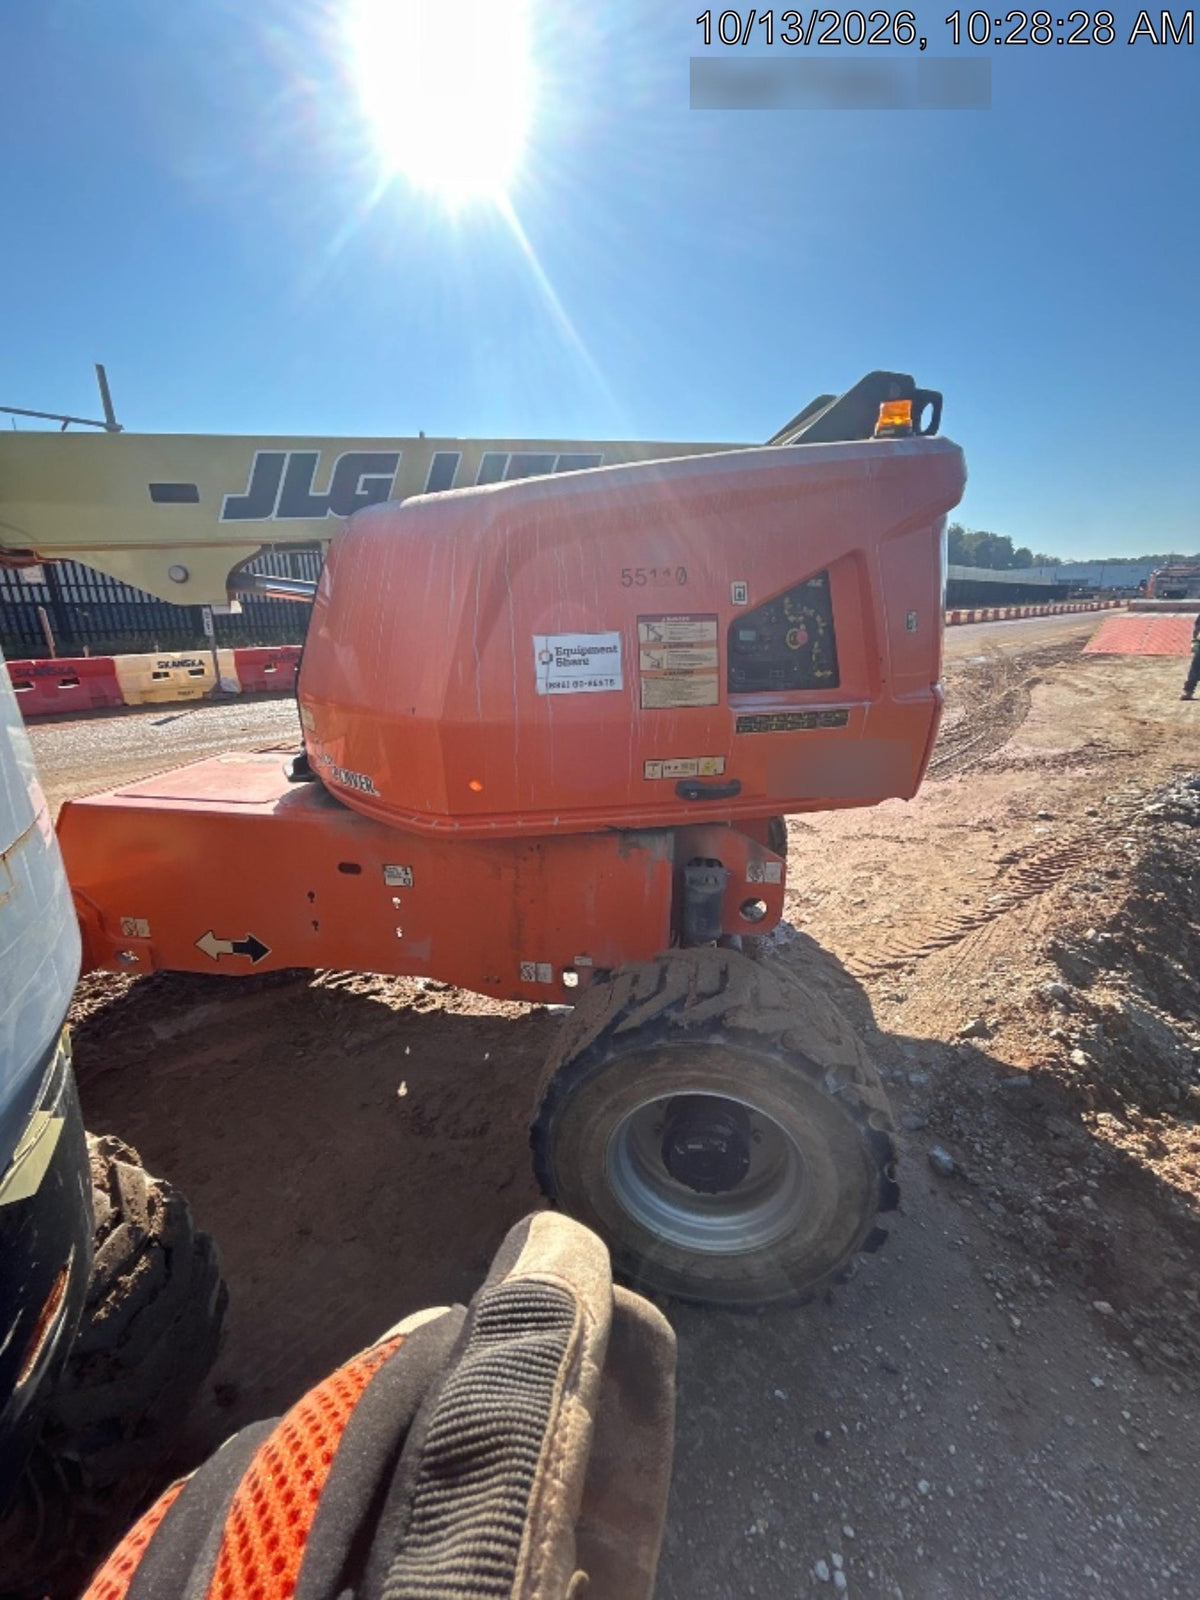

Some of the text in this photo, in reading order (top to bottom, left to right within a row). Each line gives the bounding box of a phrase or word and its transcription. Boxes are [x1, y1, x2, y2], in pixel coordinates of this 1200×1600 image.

[219, 450, 402, 523] JLG
[554, 644, 619, 658] Equipment
[157, 658, 206, 669] SKANSKA
